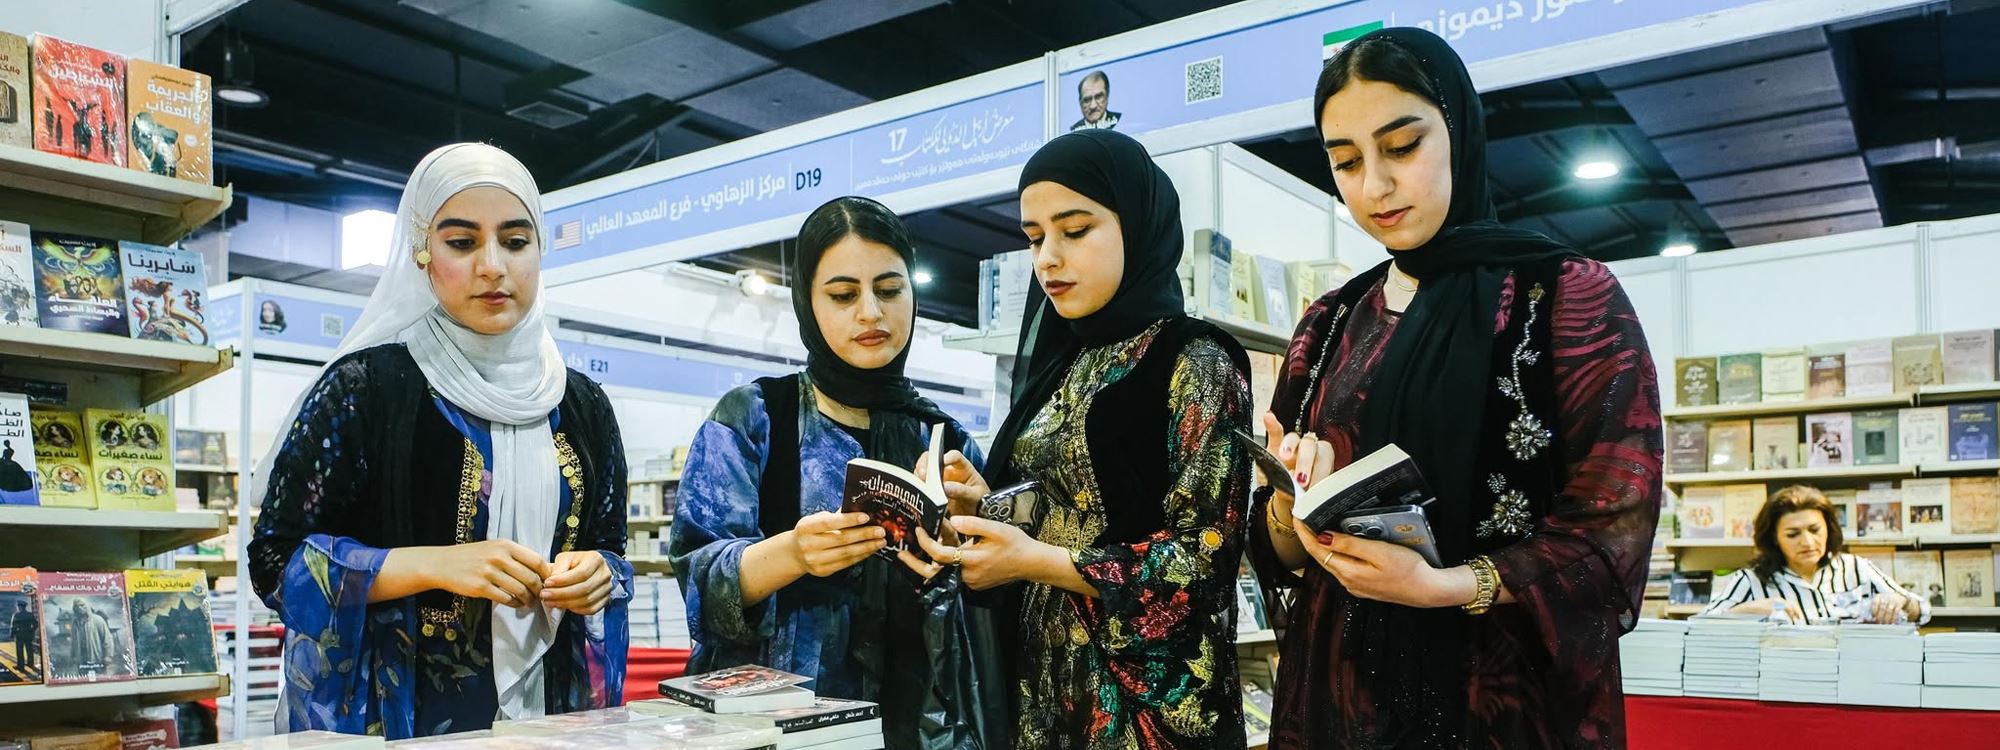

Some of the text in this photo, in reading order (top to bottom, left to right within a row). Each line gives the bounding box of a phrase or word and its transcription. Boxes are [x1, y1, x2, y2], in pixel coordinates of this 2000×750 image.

[147, 79, 201, 104] الجريمة
[145, 99, 201, 125] والعقاب
[887, 127, 908, 152] 17
[755, 173, 786, 202] مركز
[795, 168, 822, 191] D19
[669, 195, 691, 222] فرع
[701, 182, 754, 214] الزهاوي
[586, 211, 623, 241] العالي
[625, 201, 669, 227] المعهد
[590, 359, 609, 374] E21
[54, 450, 79, 459] نساء
[98, 449, 163, 460] نساء صغيرات
